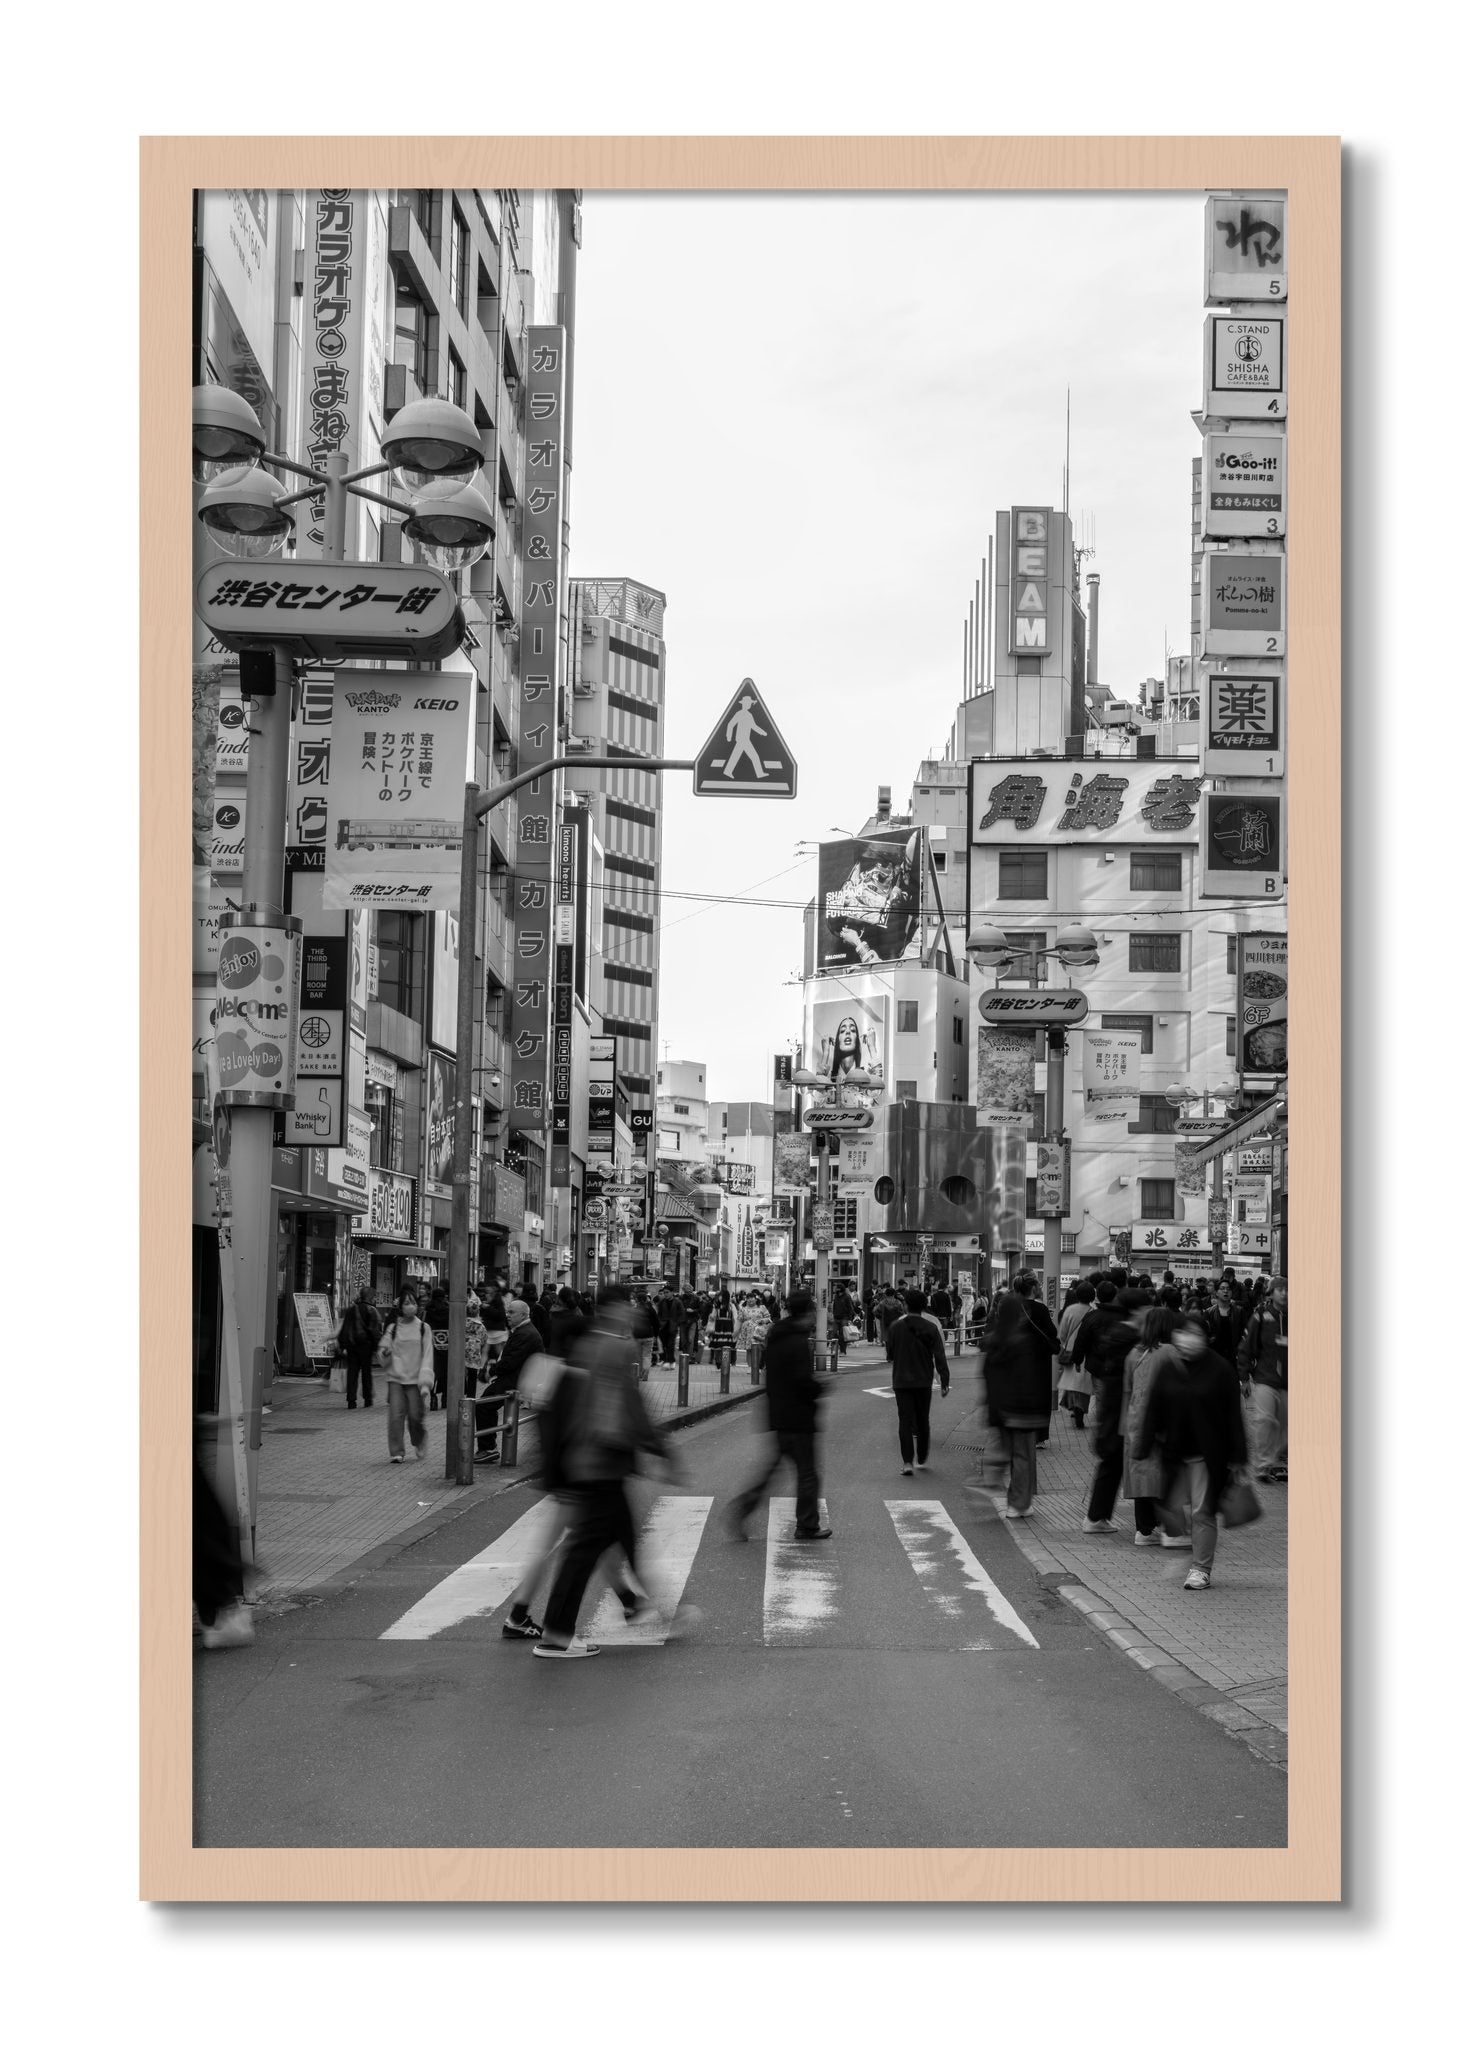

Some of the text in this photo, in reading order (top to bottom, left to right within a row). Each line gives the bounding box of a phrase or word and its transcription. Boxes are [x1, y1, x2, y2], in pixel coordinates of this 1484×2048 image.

[313, 201, 353, 330] カラオケ
[1269, 280, 1281, 295] 5
[1227, 324, 1270, 334] C.STAND
[1227, 363, 1270, 373] SHISHA
[1227, 373, 1270, 381] CAFE&BAR
[1267, 398, 1279, 413] 4
[1214, 496, 1278, 508] 全身もみほぐし
[1266, 517, 1279, 534] 3
[1016, 511, 1046, 647] BEAM
[208, 579, 442, 615] 渋谷センター街
[1215, 584, 1276, 603] ポムの樹
[1265, 637, 1278, 652] 2
[413, 698, 459, 711] KEIO
[1218, 682, 1266, 731] 薬
[1213, 733, 1271, 748] マツモトキヨシ
[361, 731, 377, 772] 冒険へ
[220, 758, 244, 766] 渋谷店
[378, 732, 396, 802] カントーの
[417, 732, 435, 789] 京王線で
[1265, 757, 1274, 772] 1
[979, 773, 1202, 830] 角海老
[1213, 809, 1271, 855] 一蘭
[216, 858, 240, 867] 渋谷店
[561, 829, 571, 899] kimono hearts
[349, 884, 433, 896] 渋谷センター街
[1264, 877, 1276, 893] B
[198, 918, 220, 927] TAM
[220, 949, 258, 982] Enjoy
[514, 882, 546, 1109] カラオケ館
[216, 995, 288, 1020] Welcome
[985, 997, 1082, 1010] 渋谷センター街
[1244, 1006, 1271, 1024] 6F
[232, 1051, 261, 1070] Lovely
[262, 1051, 281, 1064] Day!
[295, 1112, 327, 1123] Whisky
[633, 1115, 652, 1126] GU
[807, 1113, 864, 1121] 渋谷センター街
[294, 1121, 314, 1130] Bank
[1178, 1122, 1231, 1130] 渋谷センター街
[1145, 1228, 1201, 1248] 兆楽
[744, 1226, 752, 1267] BEER
